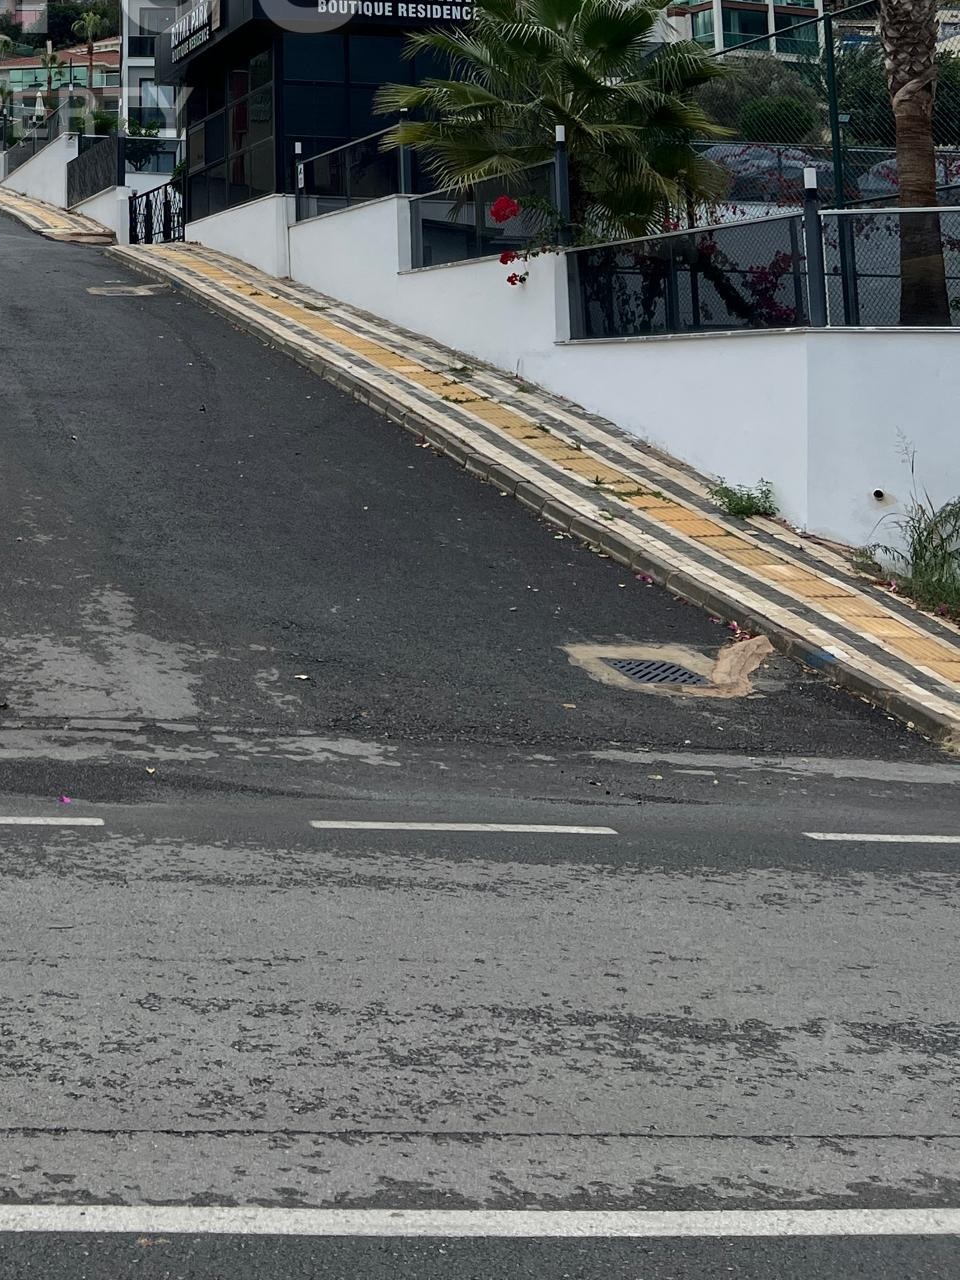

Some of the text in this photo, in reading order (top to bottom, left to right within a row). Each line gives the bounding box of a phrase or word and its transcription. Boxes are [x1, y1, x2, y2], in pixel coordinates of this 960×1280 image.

[191, 1, 209, 34] PARK
[317, 0, 481, 21] BOUTIQUE RESIDENCE
